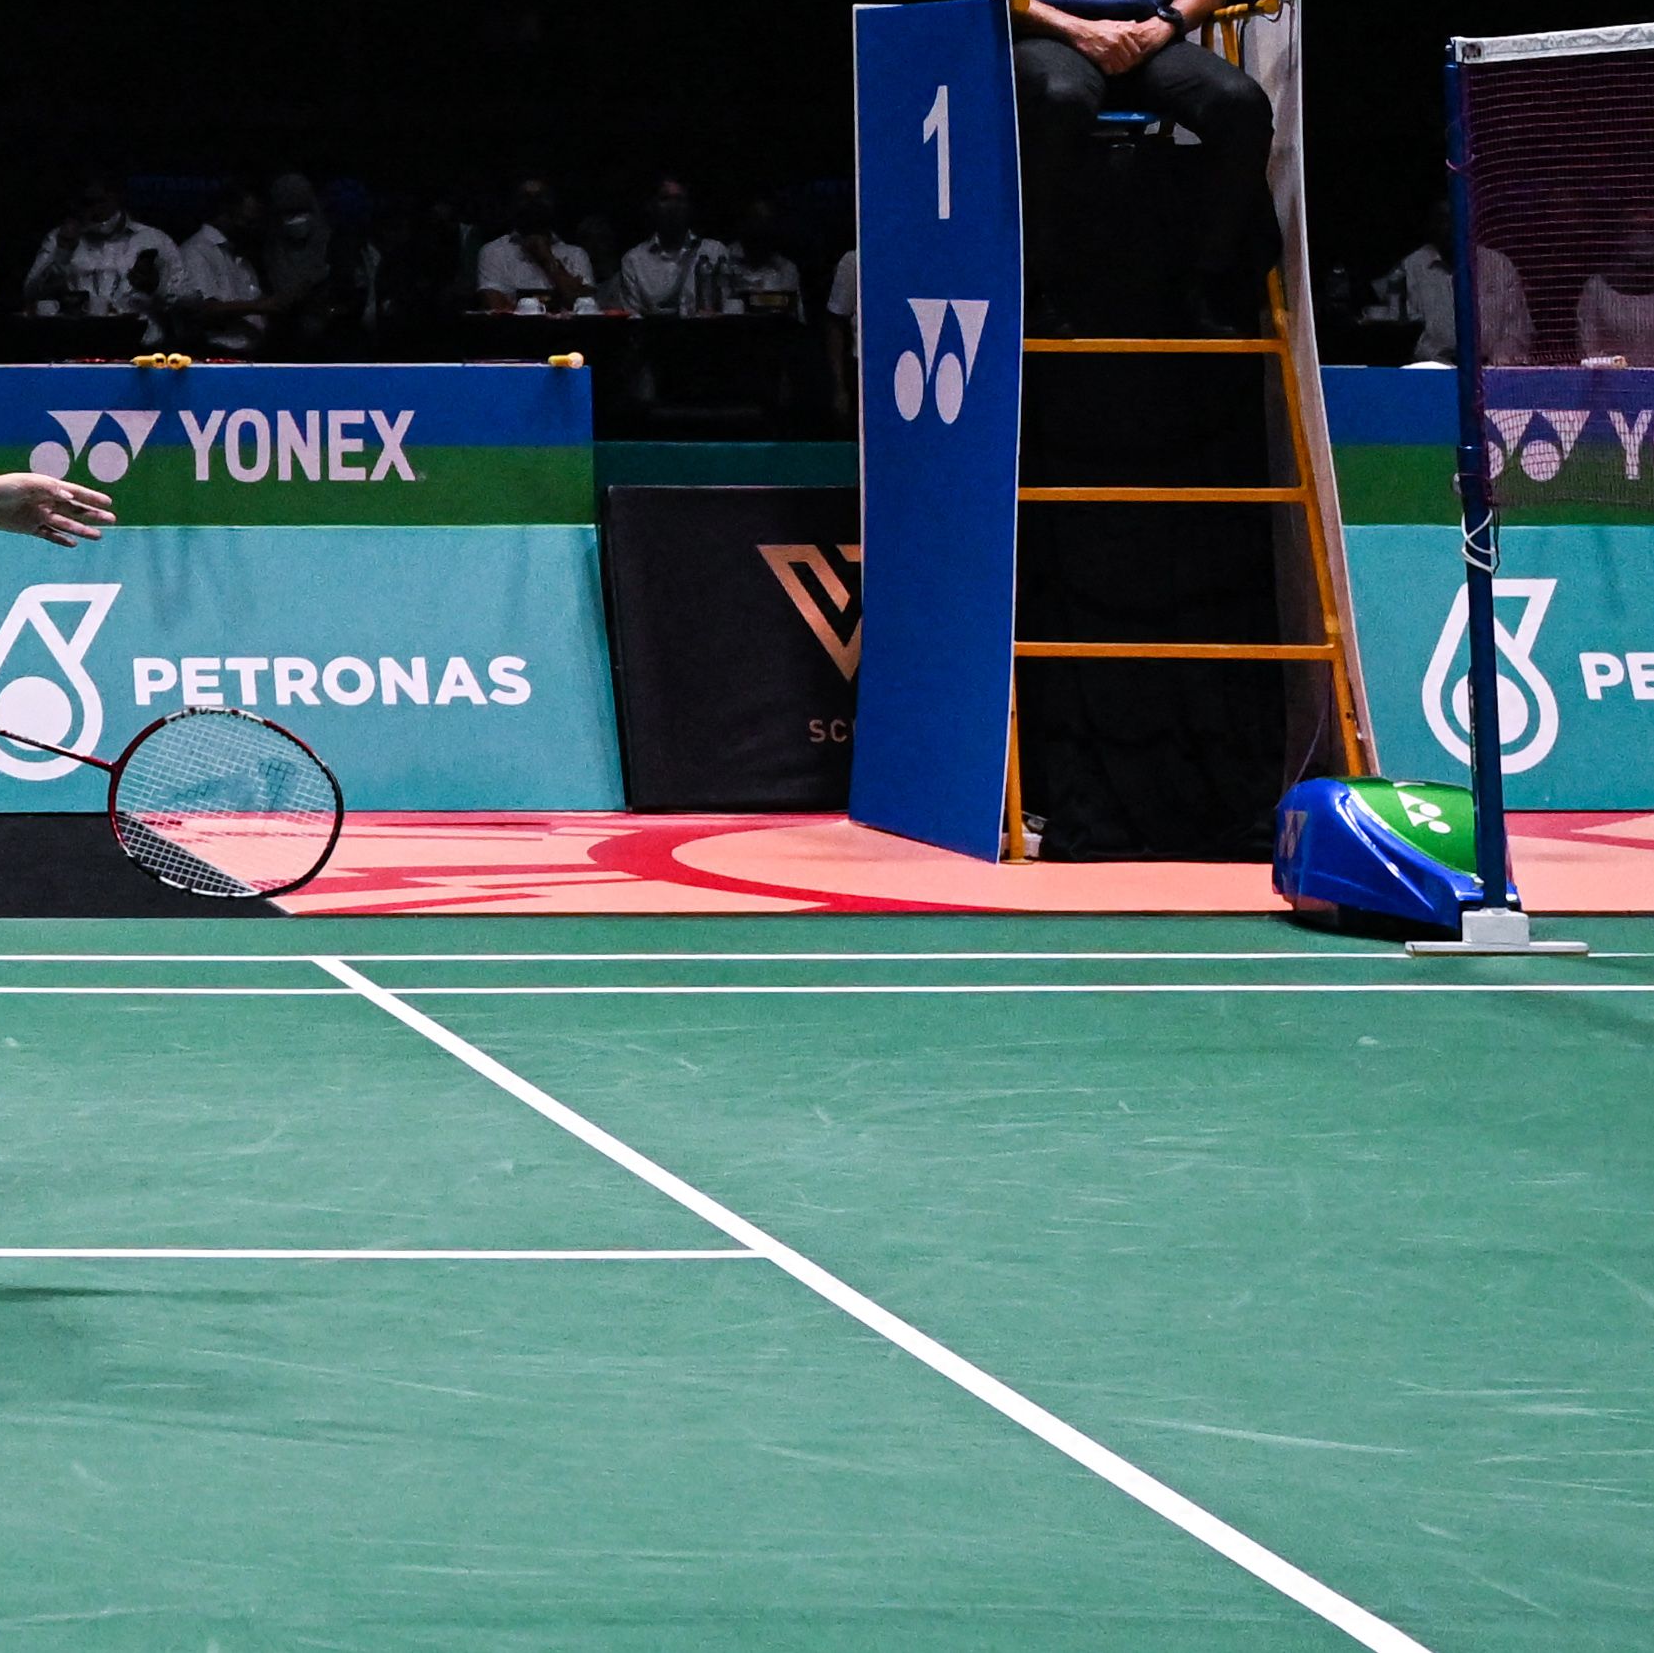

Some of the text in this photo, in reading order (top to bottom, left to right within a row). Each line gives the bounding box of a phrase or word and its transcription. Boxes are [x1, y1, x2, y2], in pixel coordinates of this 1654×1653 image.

[923, 85, 951, 220] 1
[178, 408, 416, 483] YONEX
[132, 655, 532, 706] PETRONAS
[1579, 652, 1654, 700] PE
[808, 719, 857, 743] SC
